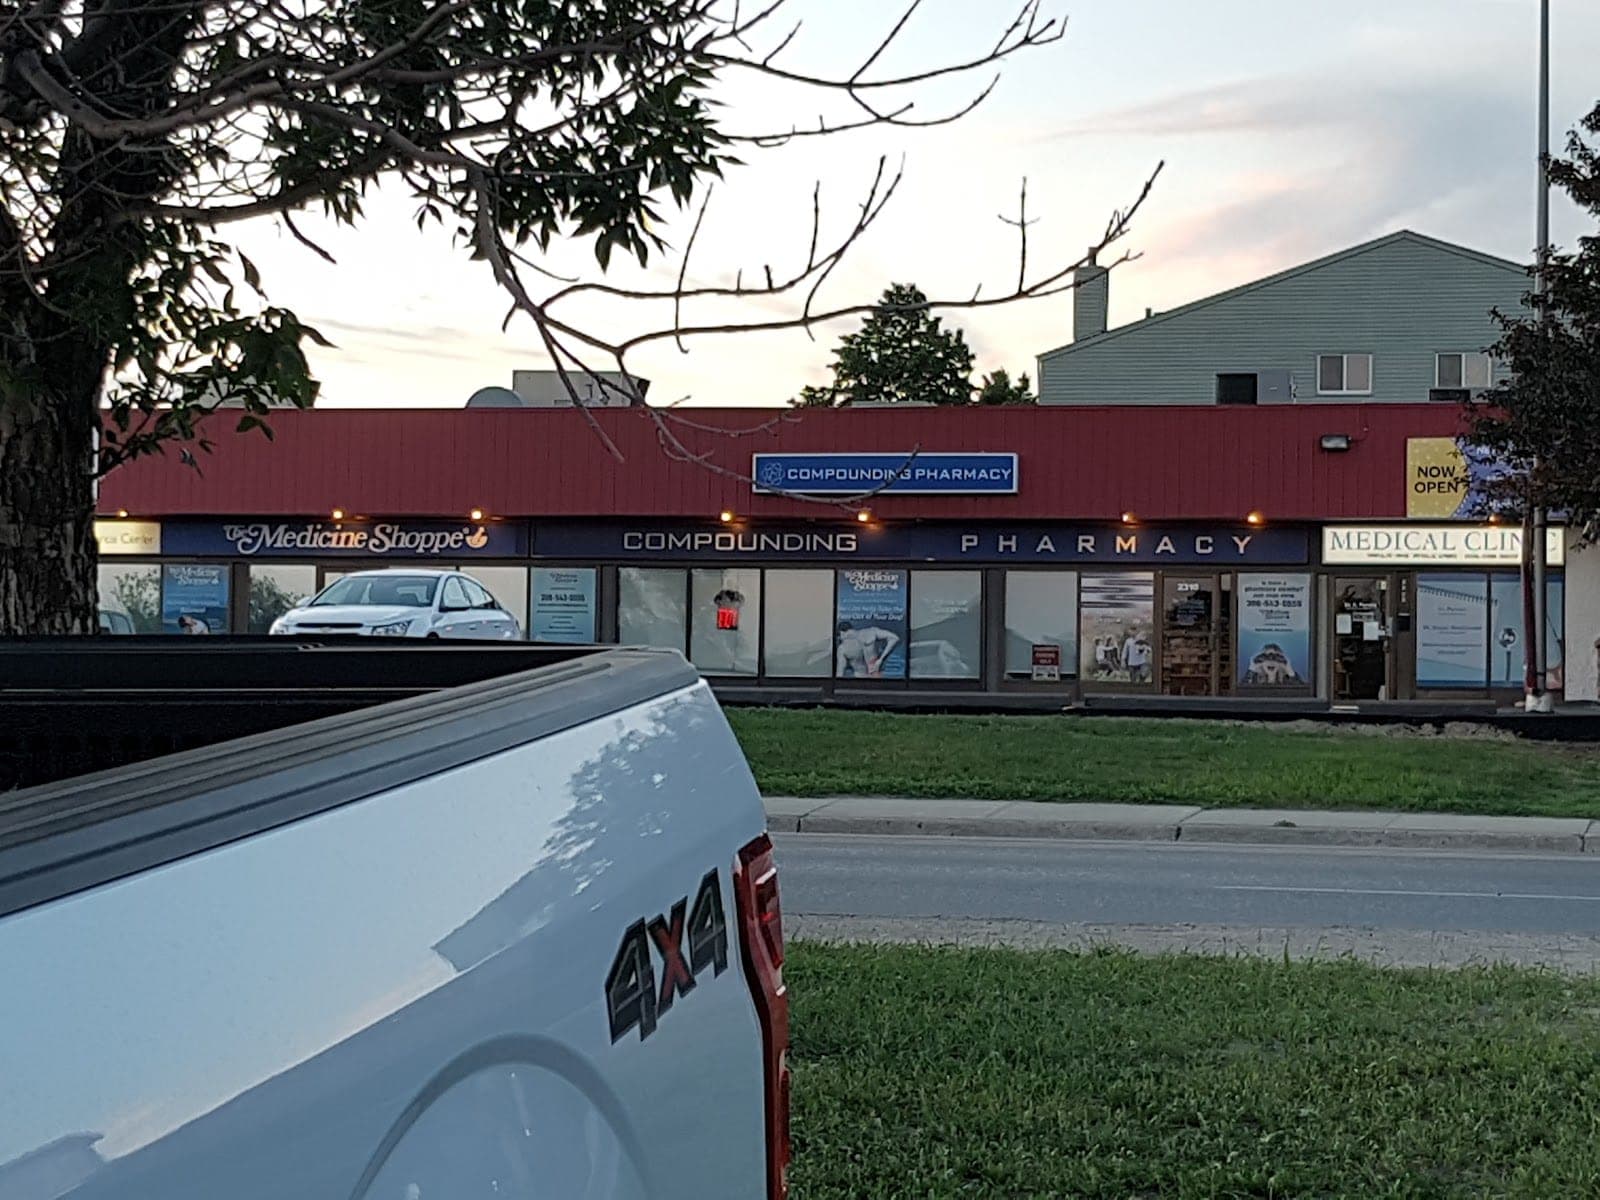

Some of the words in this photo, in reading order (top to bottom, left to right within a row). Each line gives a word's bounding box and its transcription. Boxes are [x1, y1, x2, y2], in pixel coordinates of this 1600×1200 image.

[787, 467, 911, 481] COMPOUNDING
[915, 467, 1013, 481] PHARMACY
[1417, 465, 1456, 478] NOW
[1415, 480, 1460, 494] OPEN
[238, 524, 368, 554] Medicine
[369, 523, 464, 554] Shoppe
[623, 531, 858, 553] COMPOUNDING
[960, 534, 1253, 555] PHARMACY
[1330, 530, 1456, 551] MEDICAL
